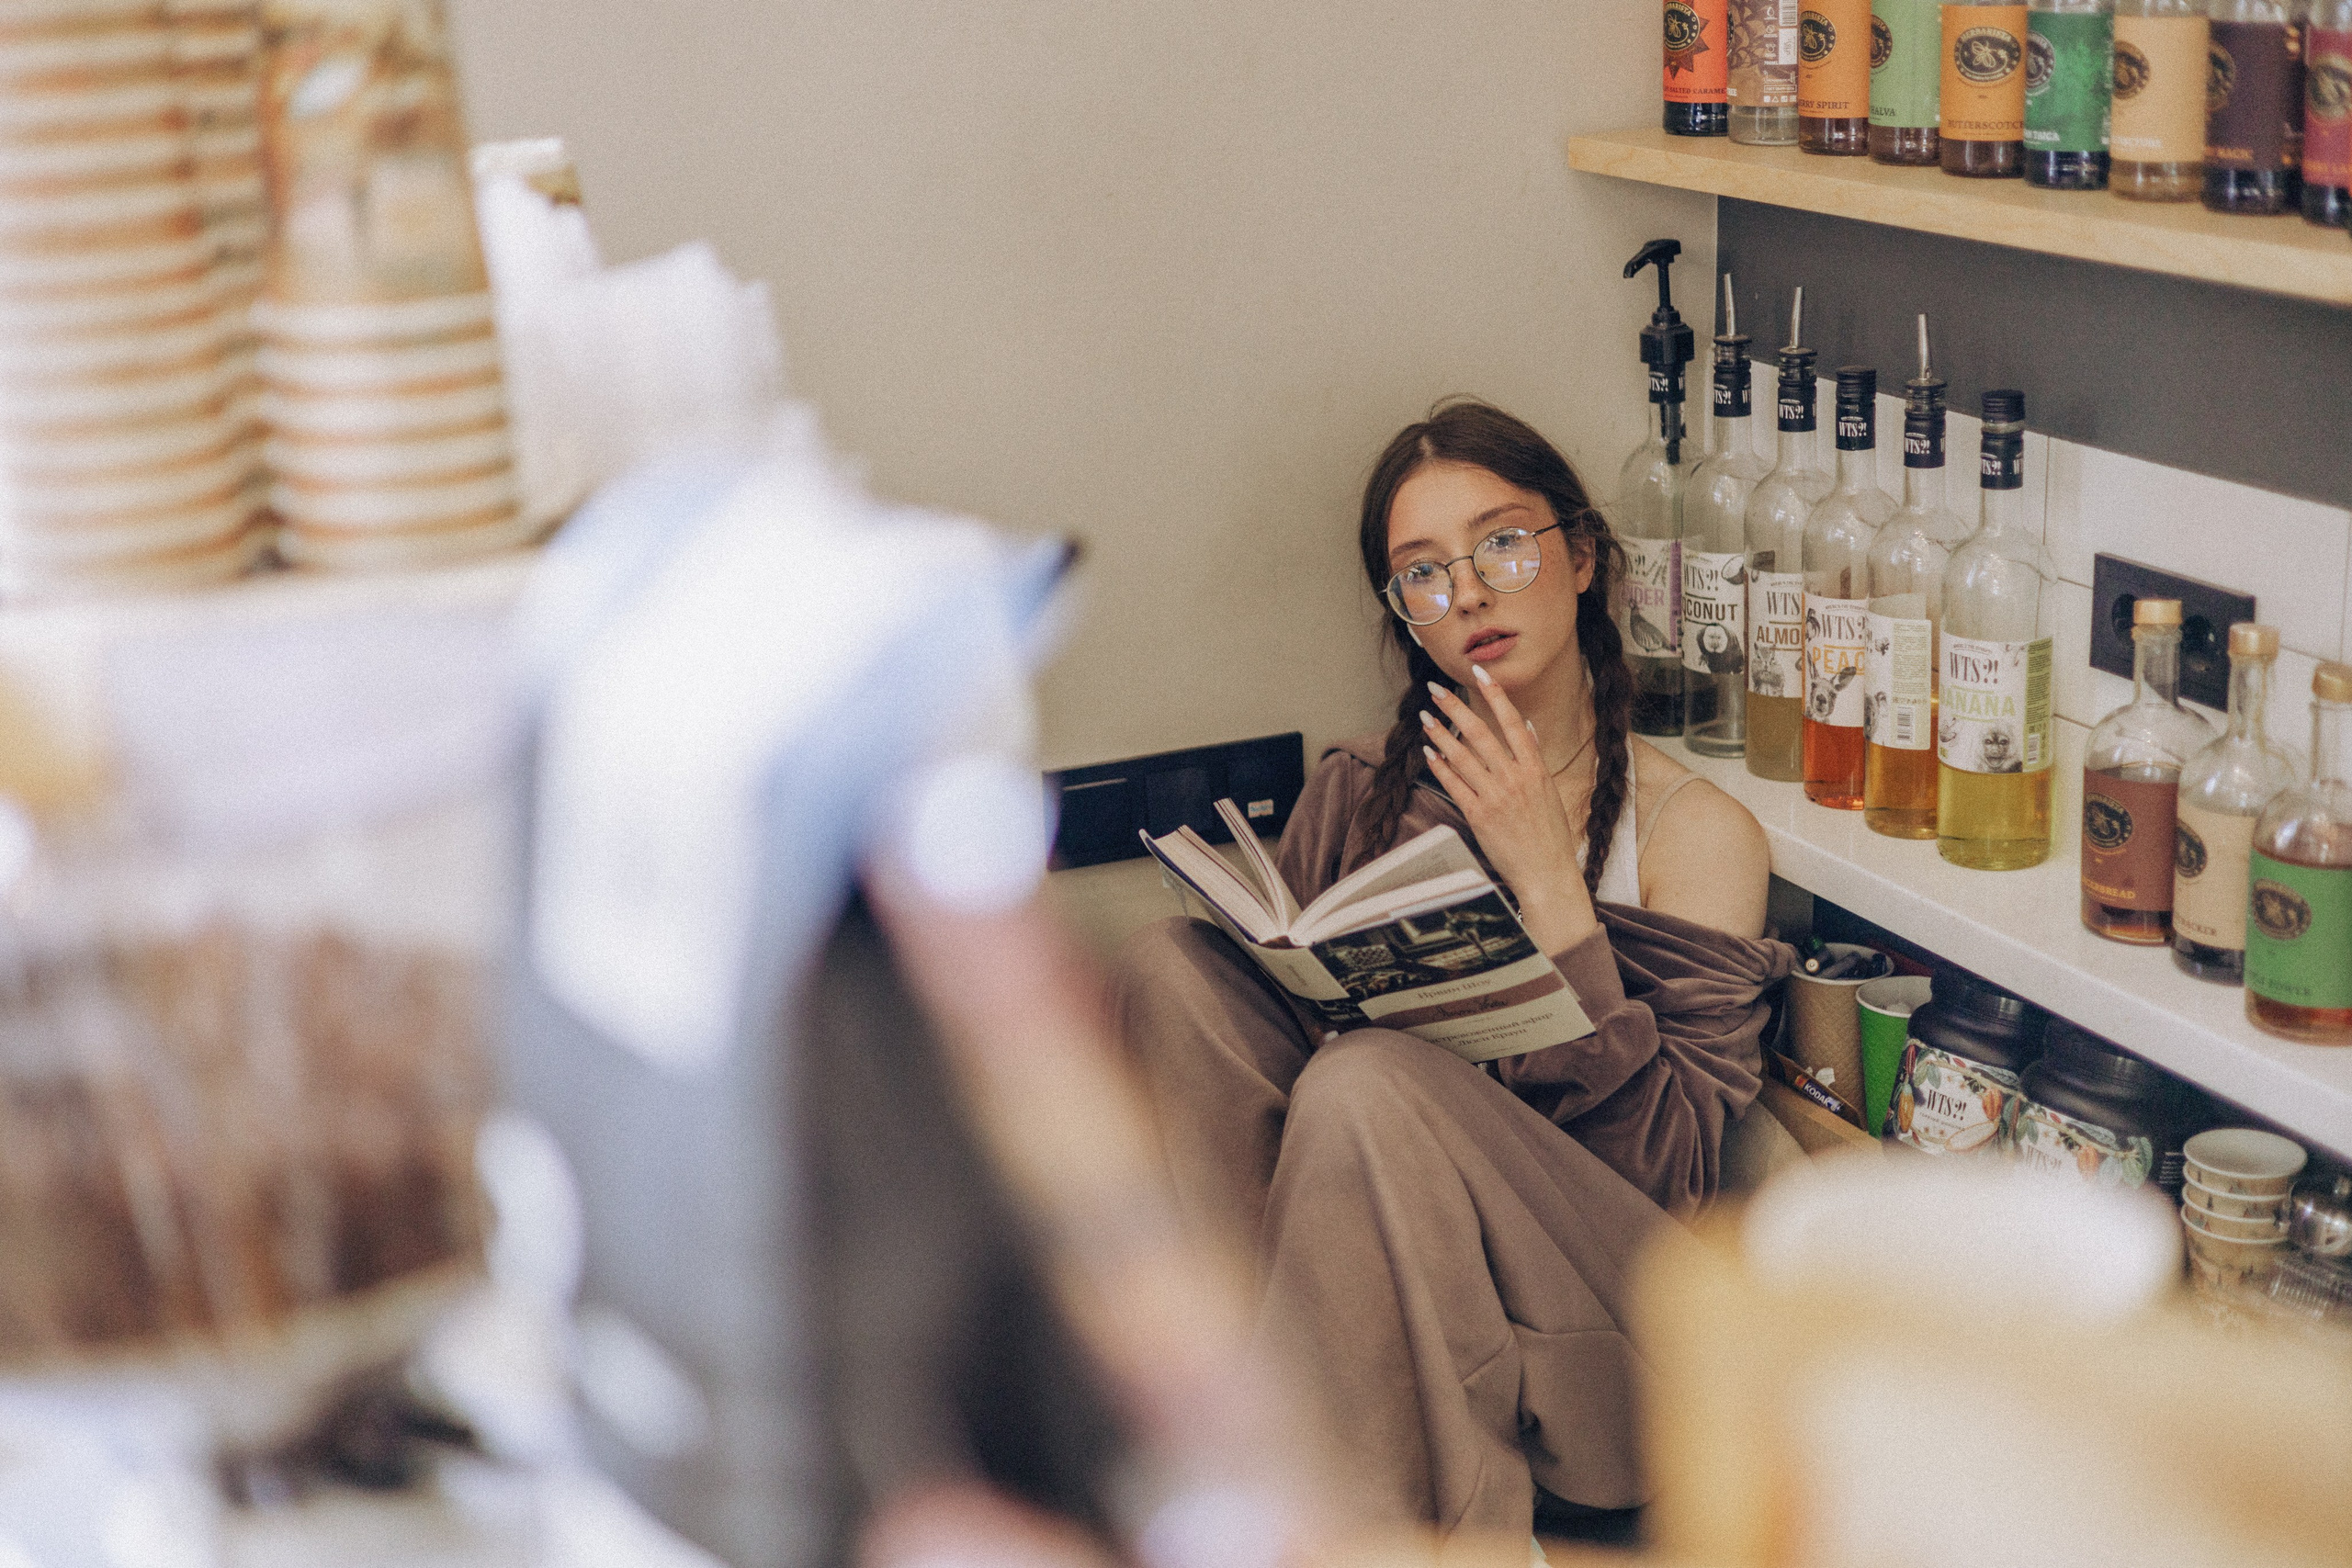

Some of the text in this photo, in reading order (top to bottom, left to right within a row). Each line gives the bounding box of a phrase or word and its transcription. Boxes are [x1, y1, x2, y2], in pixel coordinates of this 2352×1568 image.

[1798, 98, 1849, 109] ERRY SPIRIT
[1650, 377, 1669, 392] TS?!
[1714, 389, 1732, 404] TS?!
[1779, 403, 1804, 419] WTS?!
[1839, 422, 1868, 436] WTS?!
[1982, 458, 2002, 475] TS?!
[1766, 591, 1801, 615] WTS
[1756, 625, 1801, 645] ALMO
[1822, 614, 1866, 640] WTS?
[1813, 646, 1865, 672] PEAC
[1950, 651, 1999, 684] WTS?!
[1927, 1089, 1967, 1121] WTS?!
